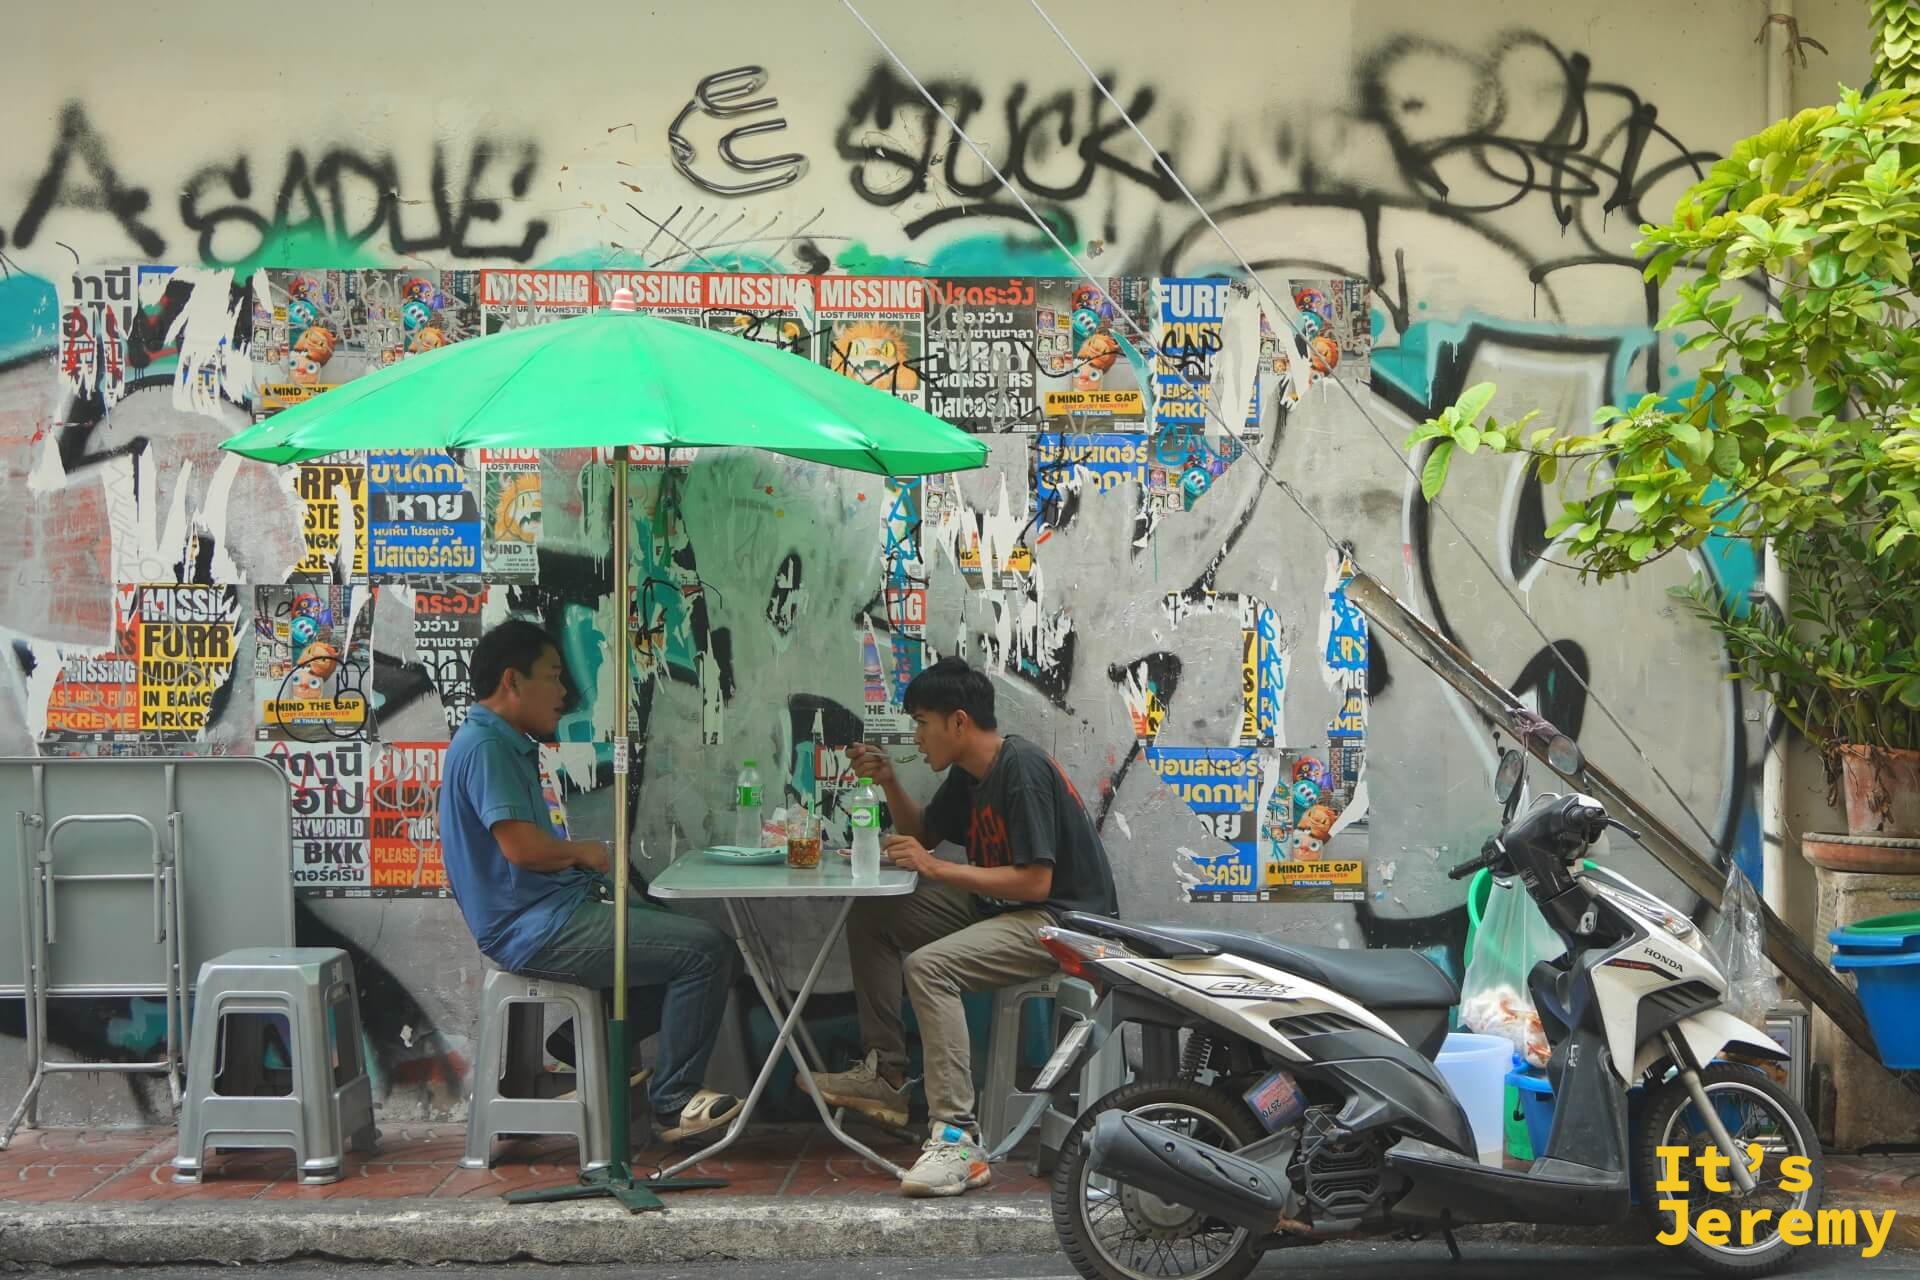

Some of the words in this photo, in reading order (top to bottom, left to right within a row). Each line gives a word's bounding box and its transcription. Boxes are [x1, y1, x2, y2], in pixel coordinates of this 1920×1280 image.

[485, 272, 589, 303] MISSING
[820, 279, 922, 308] MISSING
[545, 306, 588, 314] MONSTER
[820, 311, 845, 319] LOST
[878, 312, 921, 320] MONSTER
[929, 373, 1033, 388] MONSTRS
[1057, 394, 1085, 404] MIND
[1088, 393, 1111, 403] THE
[1114, 393, 1138, 402] GAP
[294, 467, 365, 500] RRY
[386, 494, 463, 521] หาย
[305, 503, 365, 530] STES
[304, 533, 364, 550] NGKK
[144, 624, 232, 657] FURR
[108, 690, 137, 707] FID!
[143, 690, 160, 707] IN
[308, 702, 331, 711] THE
[335, 701, 360, 710] GAP
[374, 748, 447, 781] FUR
[304, 842, 363, 864] BKK
[374, 847, 417, 864] PLEASE
[1277, 864, 1305, 873] MIND
[1308, 863, 1331, 873] THE
[1333, 863, 1358, 872] GAP
[1643, 947, 1684, 973] HONDA
